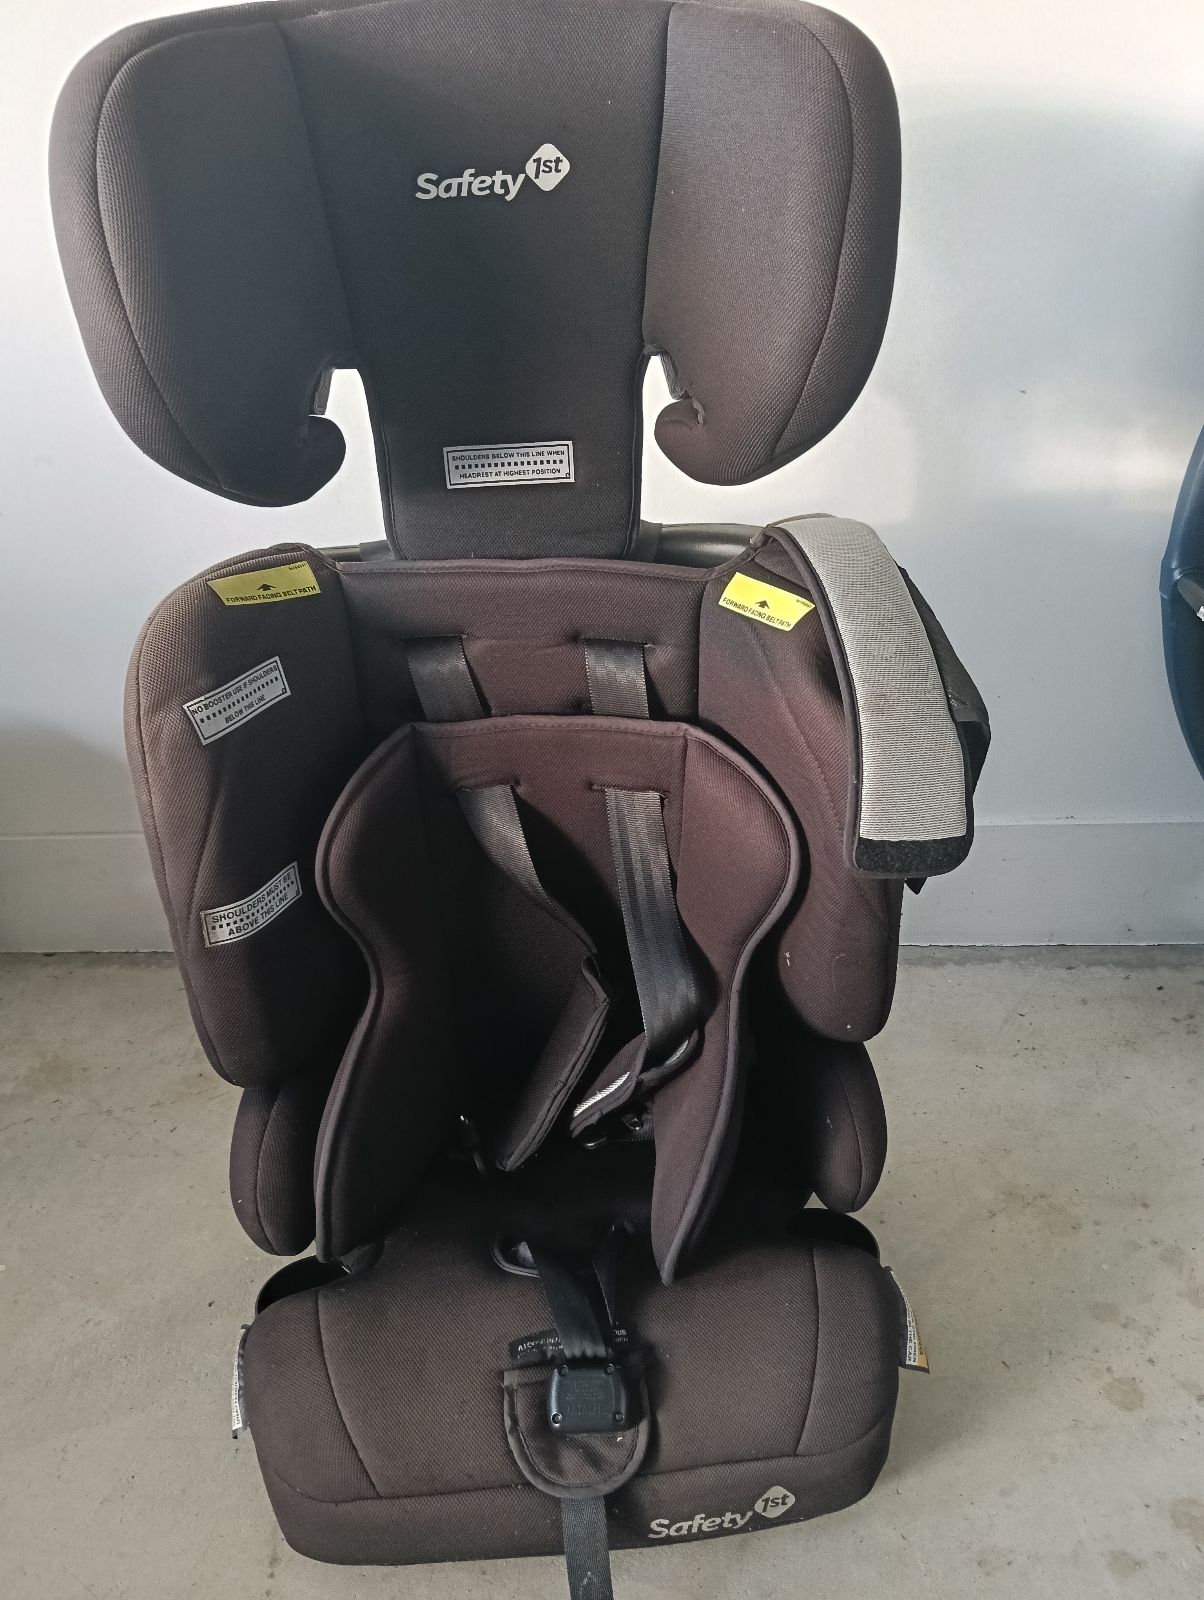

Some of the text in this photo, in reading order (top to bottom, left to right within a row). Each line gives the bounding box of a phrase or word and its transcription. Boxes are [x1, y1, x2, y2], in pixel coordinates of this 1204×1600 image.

[415, 156, 563, 202] Safety 1st
[452, 453, 490, 462] SHOULDERS
[460, 471, 493, 480] HEADREST
[226, 595, 258, 603] FORWARD
[299, 586, 316, 594] PATH
[723, 597, 792, 628] FORWARD FACING BELT PATH
[191, 665, 278, 716] NO BOOSTER USE IF SHOULDERS
[225, 694, 266, 724] BELOW THIS LINE
[211, 872, 292, 923] SHOULDERS MUST BE
[228, 893, 289, 936] ABOVE THIS LINE
[648, 1493, 790, 1539] Safety 1st
